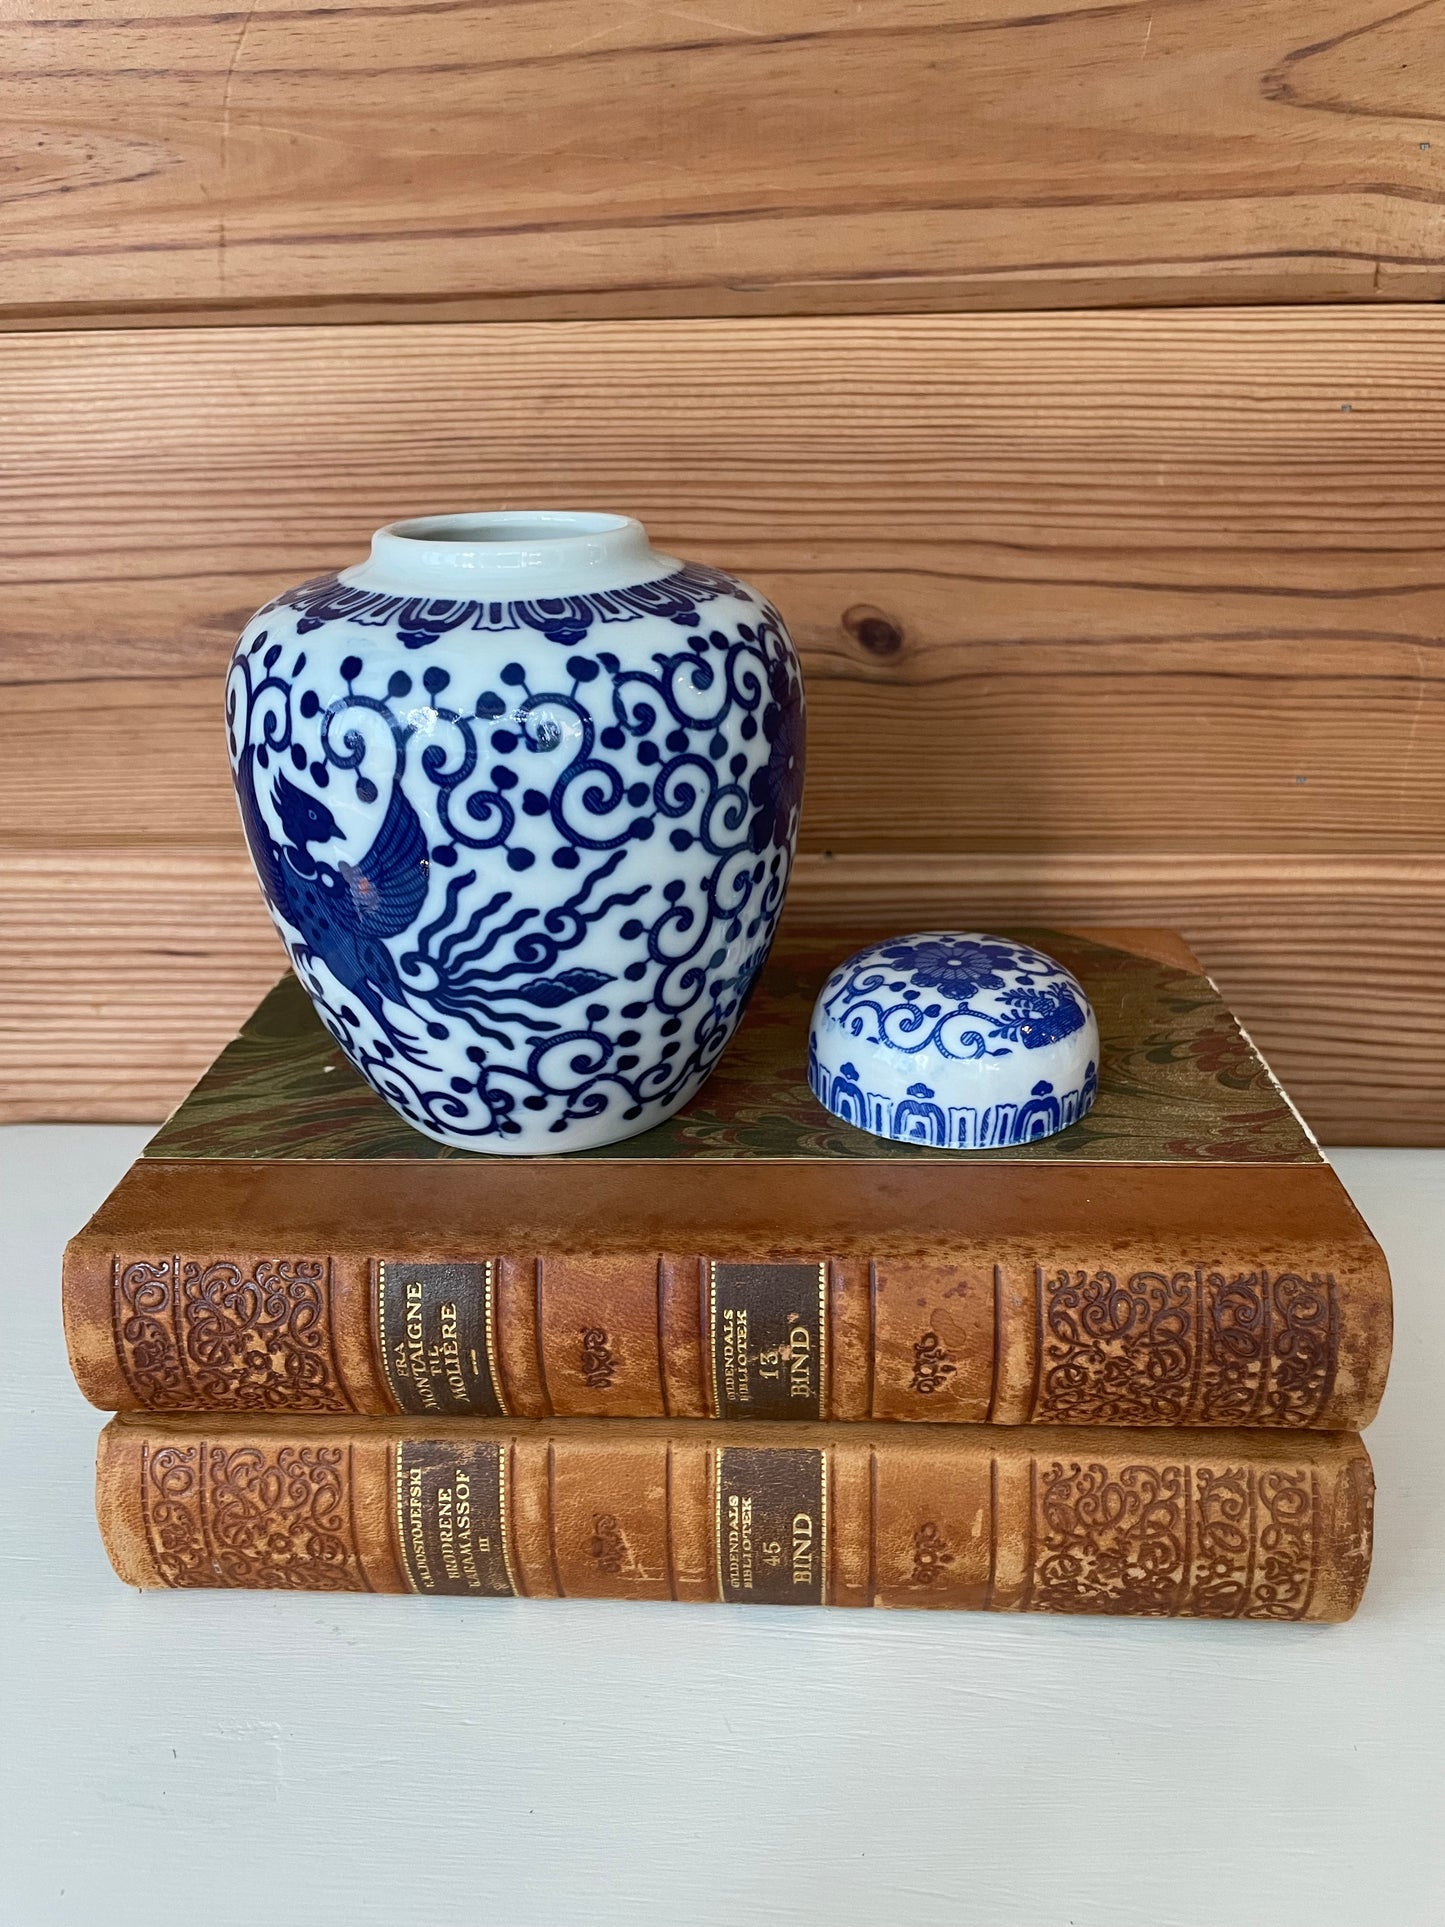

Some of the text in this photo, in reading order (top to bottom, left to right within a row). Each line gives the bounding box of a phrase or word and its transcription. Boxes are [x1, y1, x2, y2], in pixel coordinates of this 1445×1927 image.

[394, 1342, 409, 1377] FRA
[406, 1282, 440, 1410] MONTAIGNE
[428, 1345, 442, 1376] TIL
[439, 1303, 470, 1402] MOLIÈRE
[723, 1309, 736, 1400] GYLDENDALS
[759, 1351, 779, 1379] 13
[790, 1326, 810, 1398] BIND
[438, 1488, 460, 1579] BRØDRENE
[456, 1469, 480, 1587] KARAMASSOF
[478, 1536, 490, 1552] III
[728, 1495, 740, 1589] GYLDENDALS
[741, 1497, 753, 1589] BIBLIOTEK
[762, 1541, 781, 1567] 45
[792, 1513, 812, 1585] BIND
